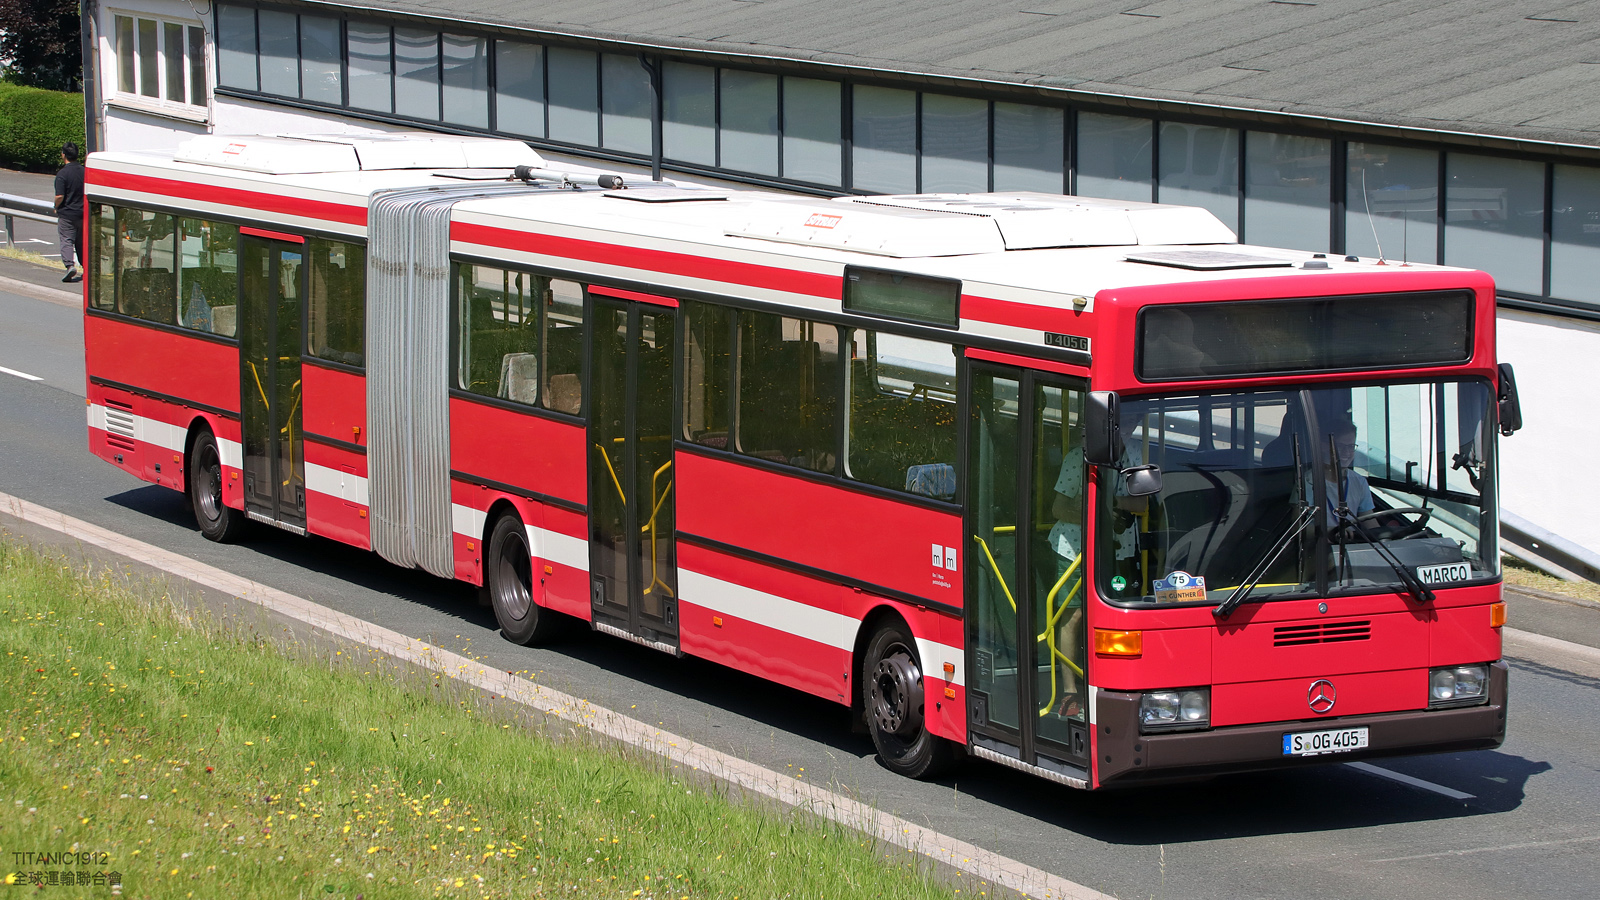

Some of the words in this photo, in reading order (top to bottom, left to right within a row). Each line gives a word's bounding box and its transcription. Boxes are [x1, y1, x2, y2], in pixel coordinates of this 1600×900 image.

[1055, 335, 1078, 349] 405
[1080, 338, 1087, 350] G
[1172, 575, 1185, 584] 75
[1423, 565, 1467, 583] MARCO
[1294, 736, 1303, 751] S
[1312, 733, 1331, 750] OG
[1333, 731, 1359, 748] 405
